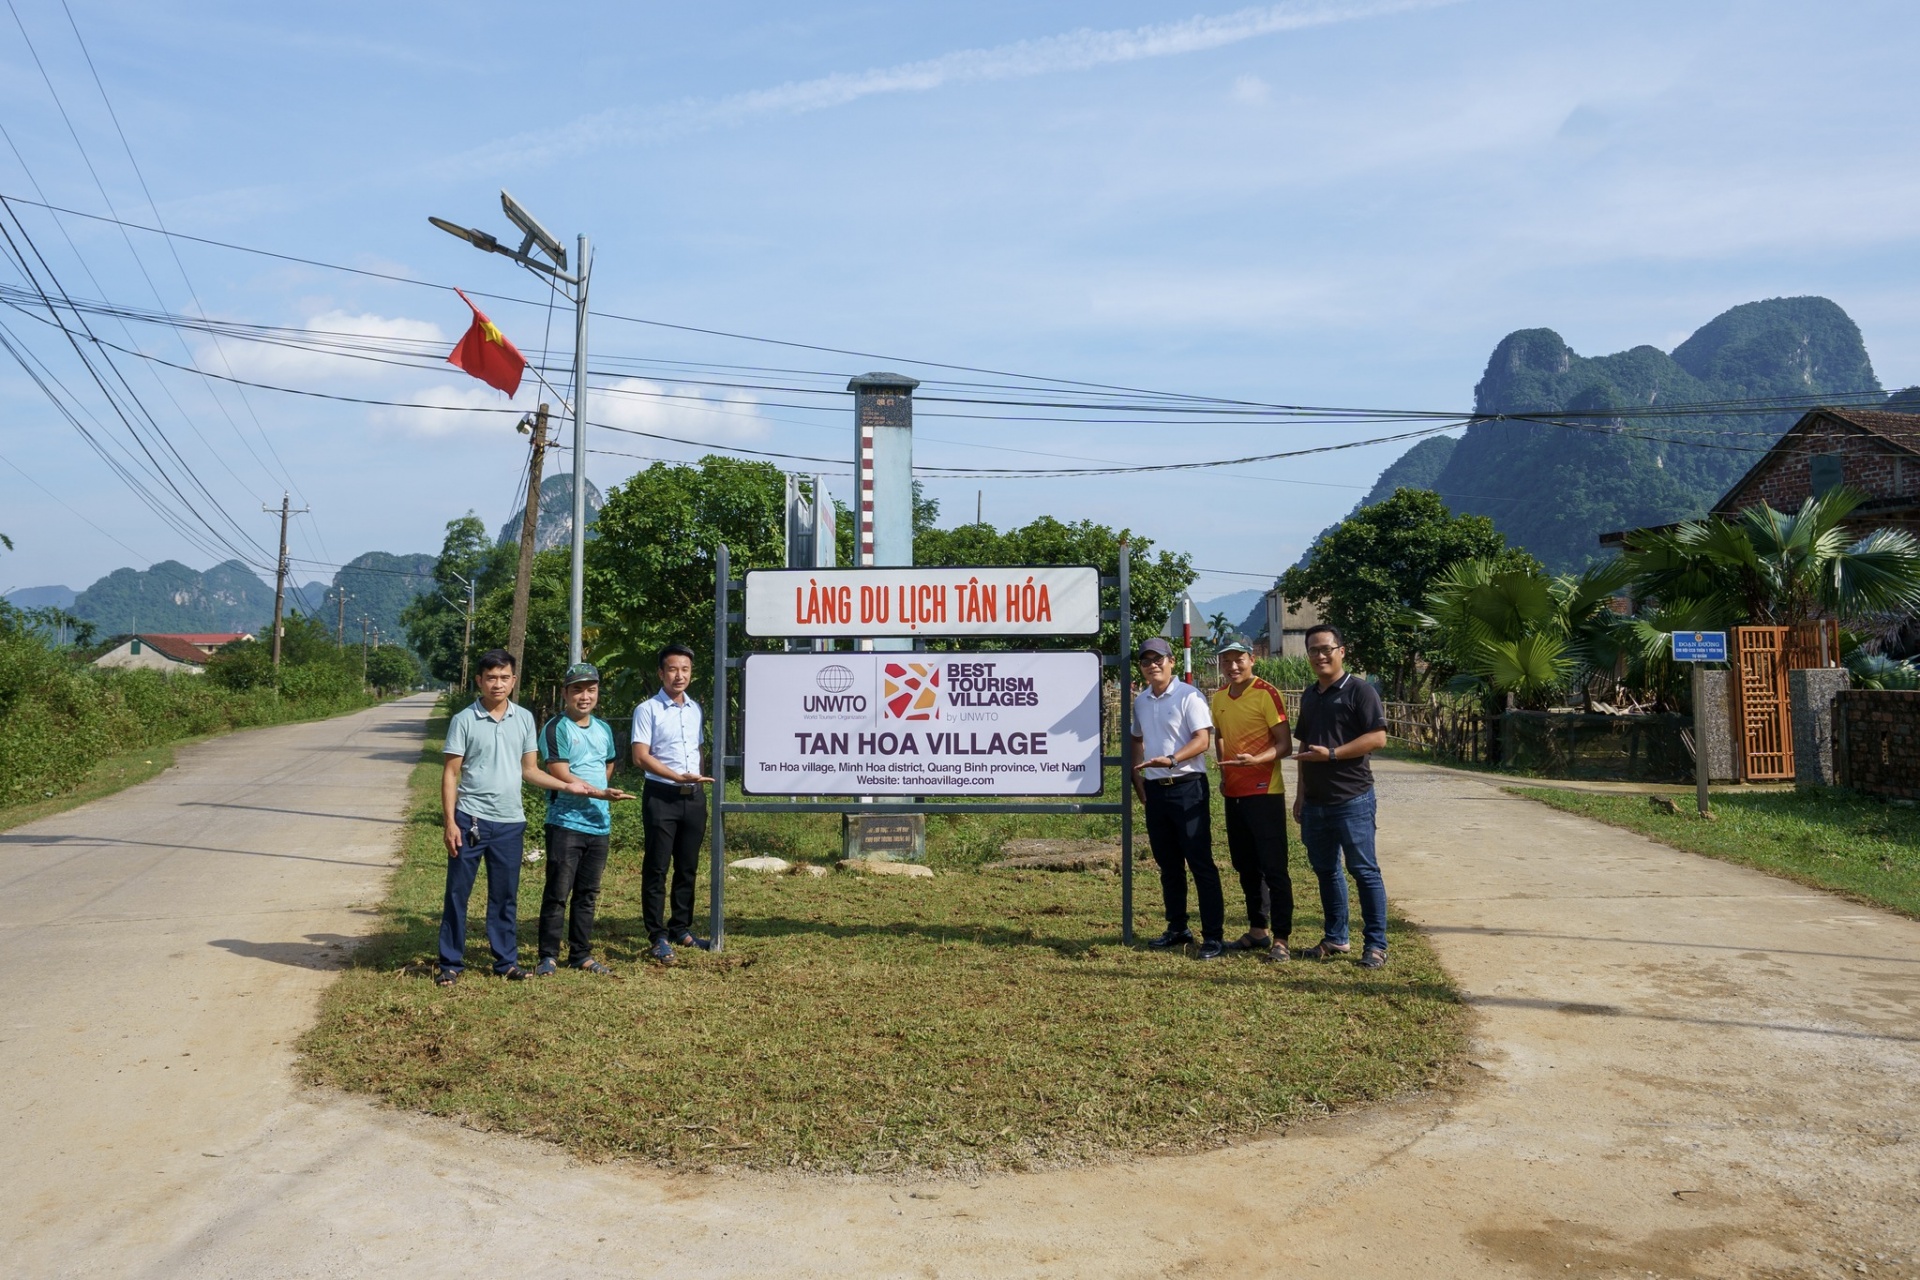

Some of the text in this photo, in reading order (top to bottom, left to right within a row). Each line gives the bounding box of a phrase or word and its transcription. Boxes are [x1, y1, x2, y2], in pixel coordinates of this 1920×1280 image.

[797, 576, 1052, 630] LÀNG DU LỊCH TÂN HÓA
[947, 663, 996, 678] BEST
[947, 677, 1035, 692] TOURISM
[803, 695, 867, 713] UNWTO
[947, 692, 1039, 707] VILLAGES
[837, 713, 867, 722] Organization
[946, 711, 999, 723] by UNWTO
[795, 732, 1048, 755] TAN HOA VILLAGE
[759, 761, 1086, 775] Tan Hoa village, Minh Hoa district, Quang Binh province, Viet Nam
[857, 774, 995, 788] Website: tanhoavillage.com
